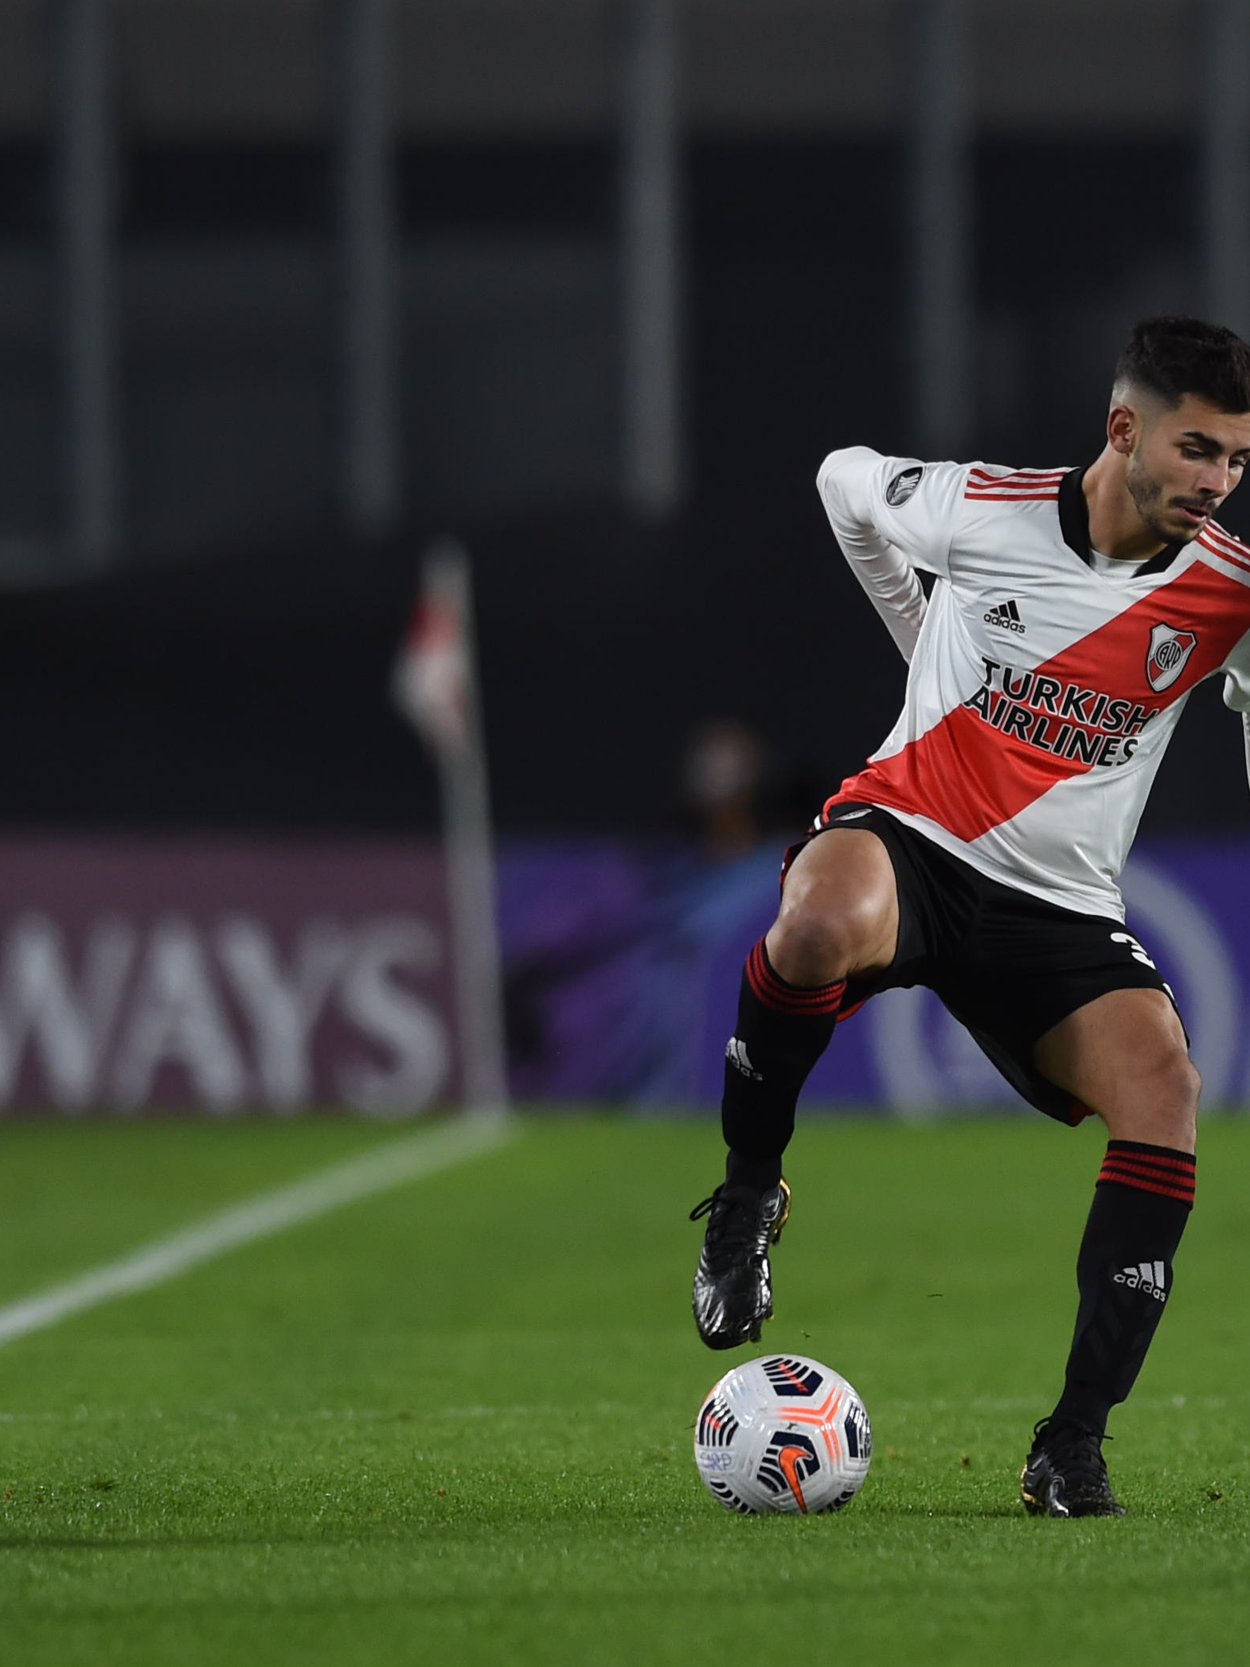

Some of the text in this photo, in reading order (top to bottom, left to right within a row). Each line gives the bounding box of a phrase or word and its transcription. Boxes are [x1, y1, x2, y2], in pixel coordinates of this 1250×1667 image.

[983, 613, 1026, 634] adidas
[981, 655, 1159, 735] TURKISH
[964, 685, 1139, 767] AIRLINES
[1113, 1273, 1166, 1303] adidas
